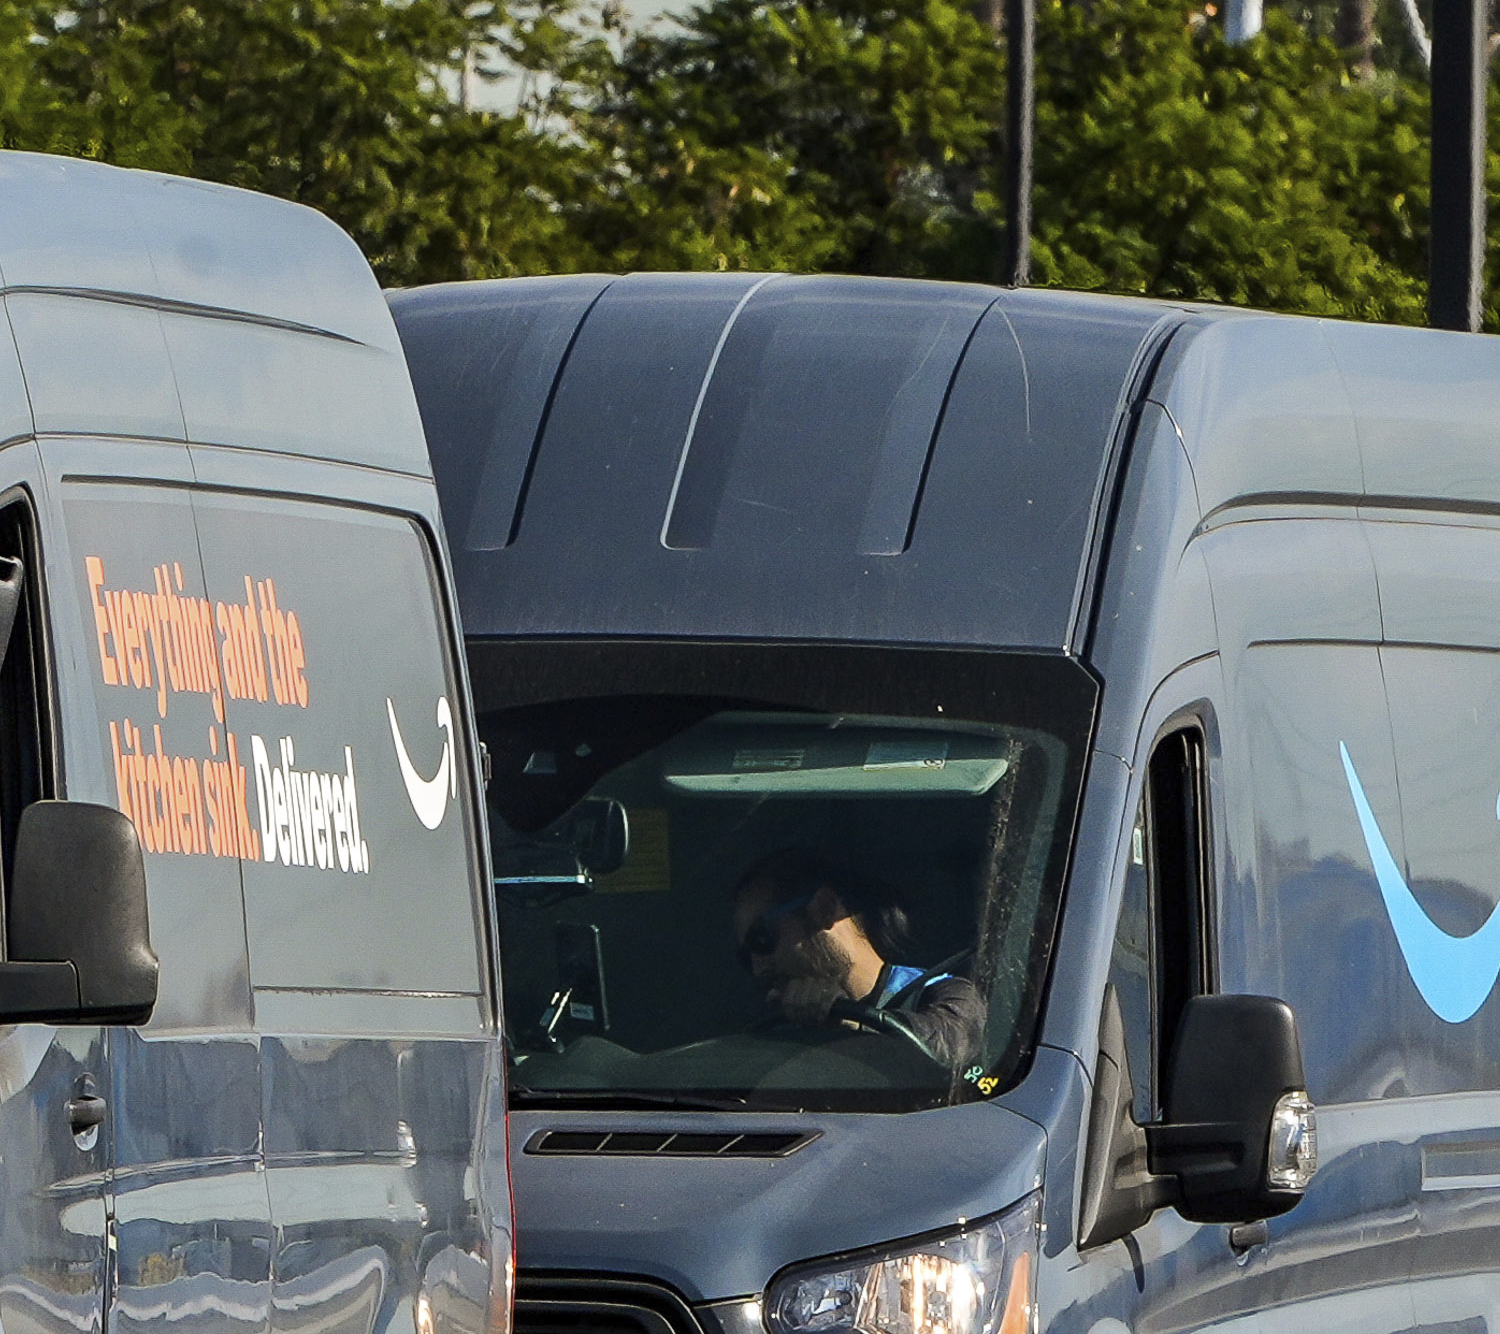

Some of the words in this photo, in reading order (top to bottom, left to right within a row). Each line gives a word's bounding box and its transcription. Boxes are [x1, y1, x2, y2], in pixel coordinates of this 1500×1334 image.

[85, 555, 226, 724] Everything
[215, 575, 269, 703] and
[257, 578, 310, 709] the
[109, 717, 209, 855] kitchen
[203, 724, 261, 863] sink.
[250, 733, 370, 874] Delivered.
